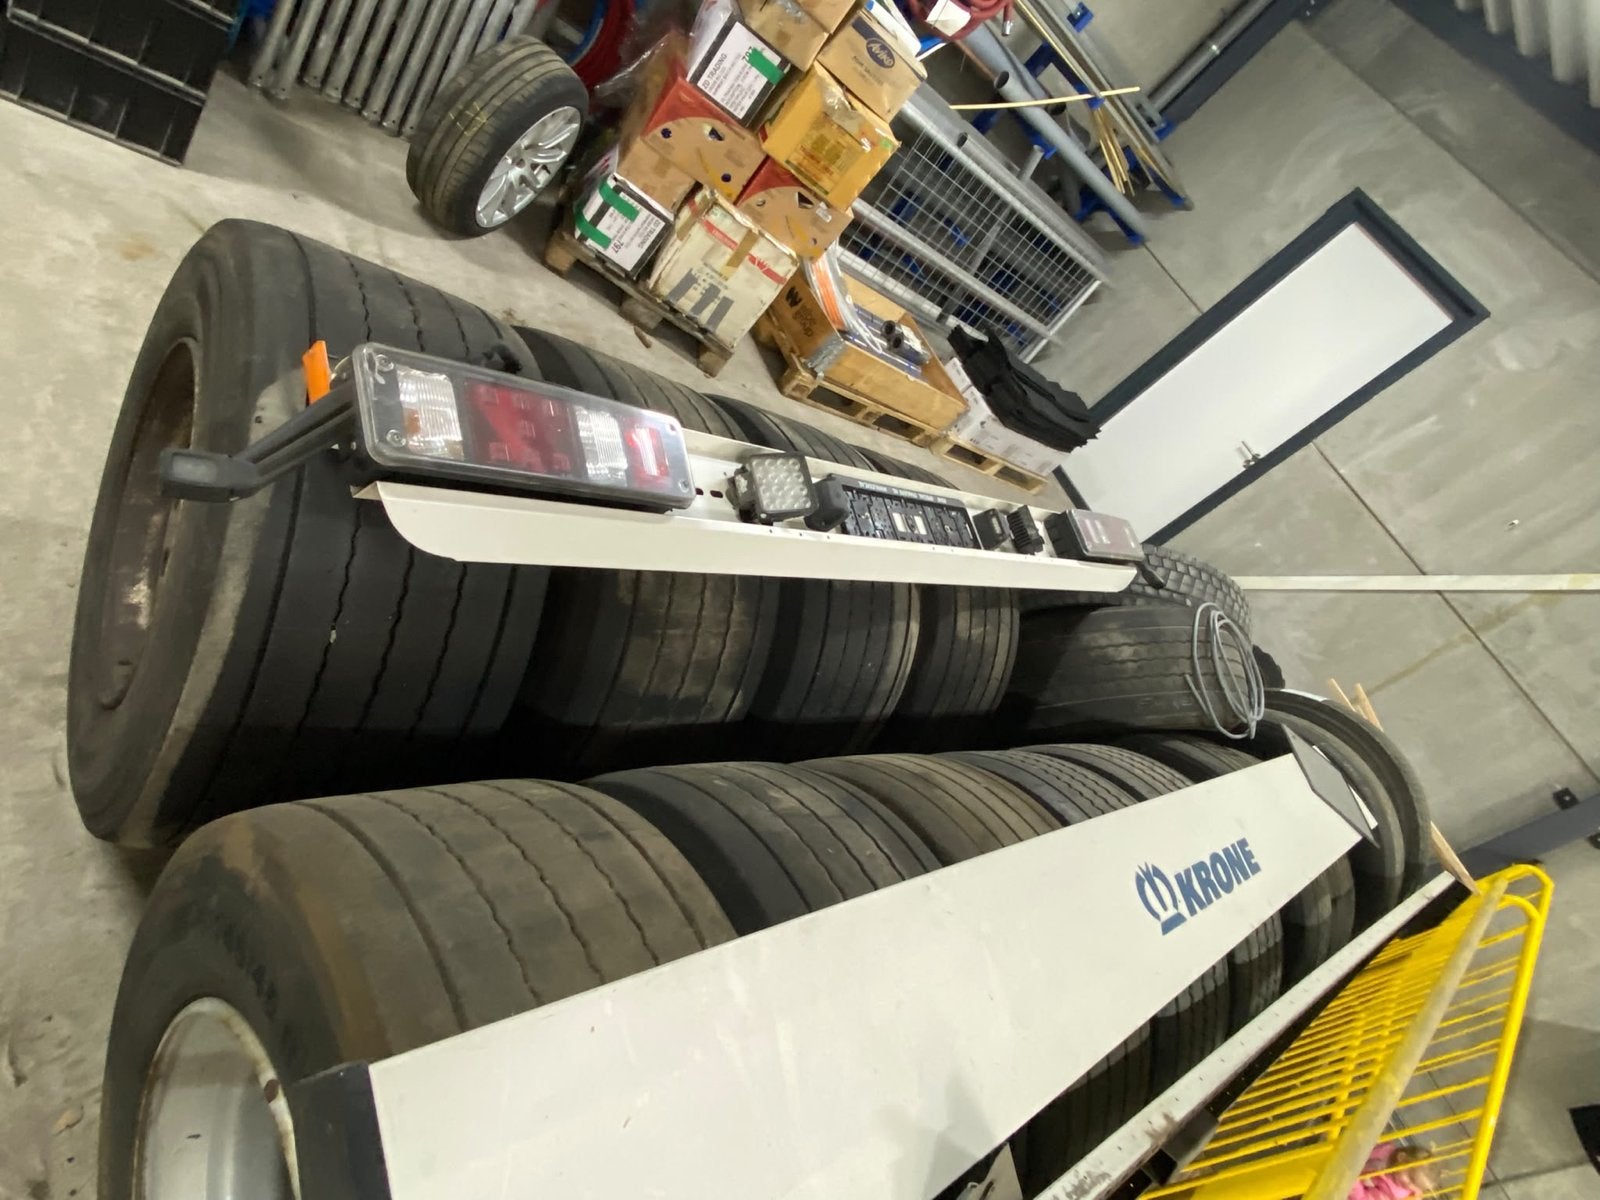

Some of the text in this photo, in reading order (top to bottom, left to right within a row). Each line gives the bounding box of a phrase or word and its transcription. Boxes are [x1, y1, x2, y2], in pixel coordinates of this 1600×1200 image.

[708, 52, 728, 81] TRADING
[612, 240, 624, 253] 797
[1173, 837, 1262, 917] KRONE
